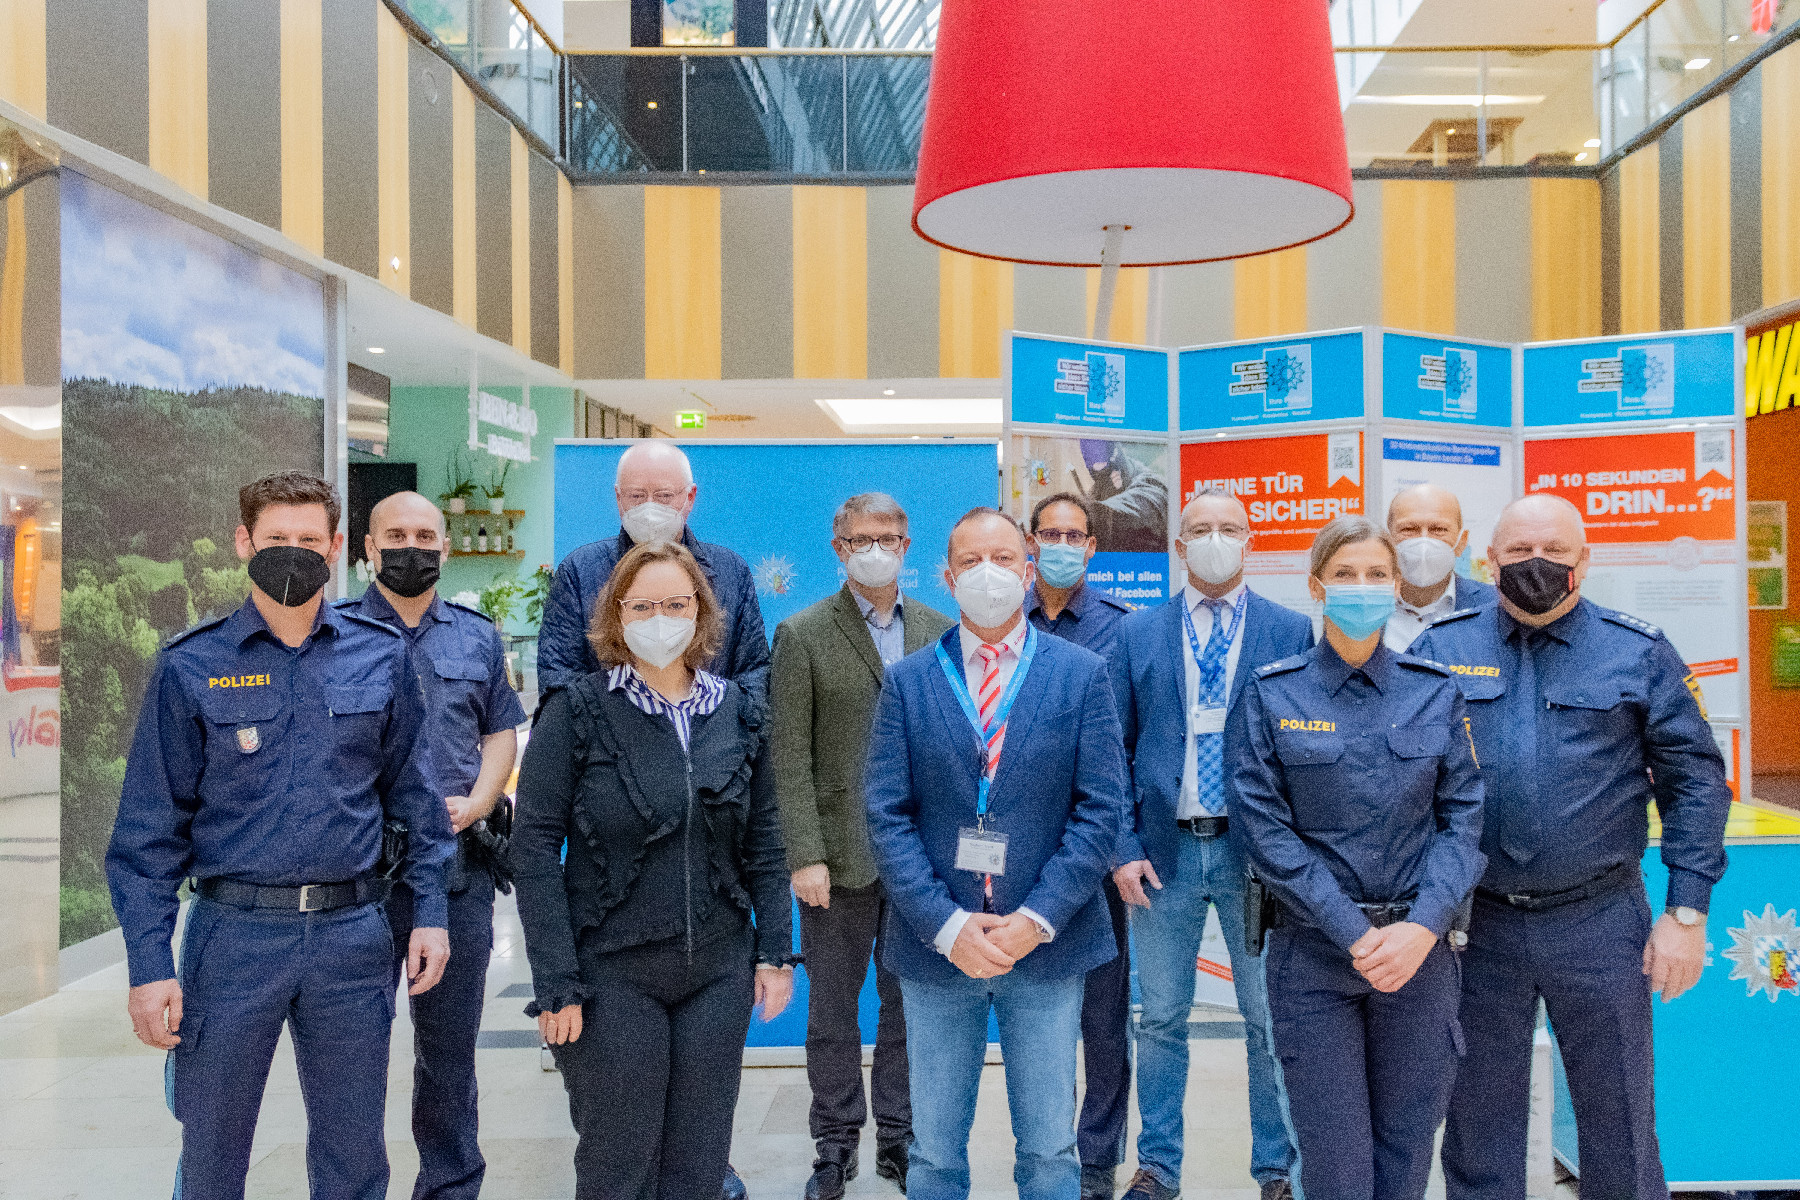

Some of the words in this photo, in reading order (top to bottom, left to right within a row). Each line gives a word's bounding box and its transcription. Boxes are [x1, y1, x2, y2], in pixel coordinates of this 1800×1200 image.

[1261, 472, 1304, 494] TÜR
[1561, 472, 1583, 488] 10
[1585, 468, 1687, 487] SEKUNDEN
[1087, 570, 1114, 582] mich
[1117, 570, 1135, 582] bei
[1137, 570, 1162, 582] allen
[1115, 587, 1162, 598] Facebook
[208, 673, 271, 689] POLIZEI
[1279, 718, 1336, 732] POLIZEI
